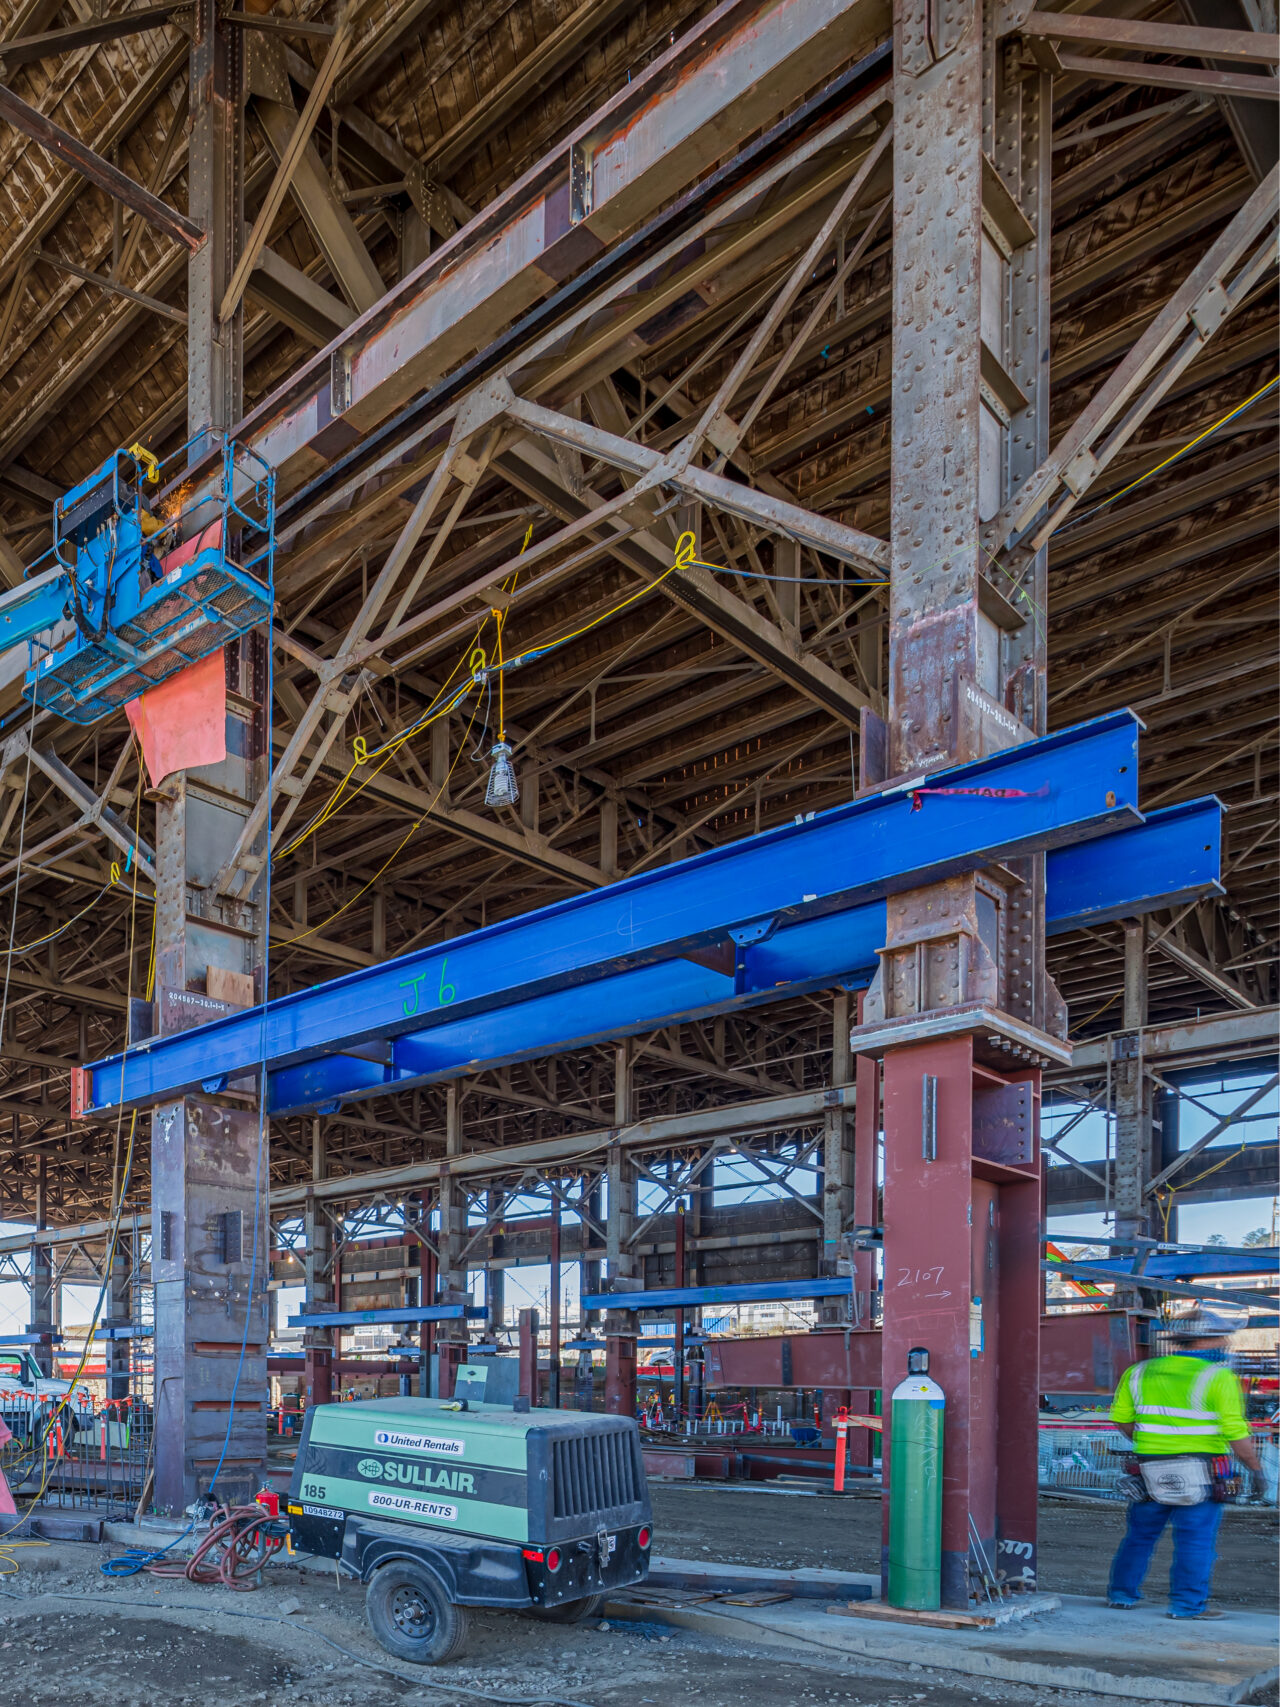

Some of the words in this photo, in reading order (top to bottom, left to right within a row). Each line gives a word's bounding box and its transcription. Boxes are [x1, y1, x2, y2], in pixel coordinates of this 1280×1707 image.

[897, 1266, 945, 1287] 2107
[390, 1434, 421, 1449] United
[423, 1439, 460, 1453] Rentals
[383, 1461, 475, 1494] SULLAIR
[304, 1484, 327, 1500] 185
[372, 1494, 454, 1518] 800-UR-RENTS
